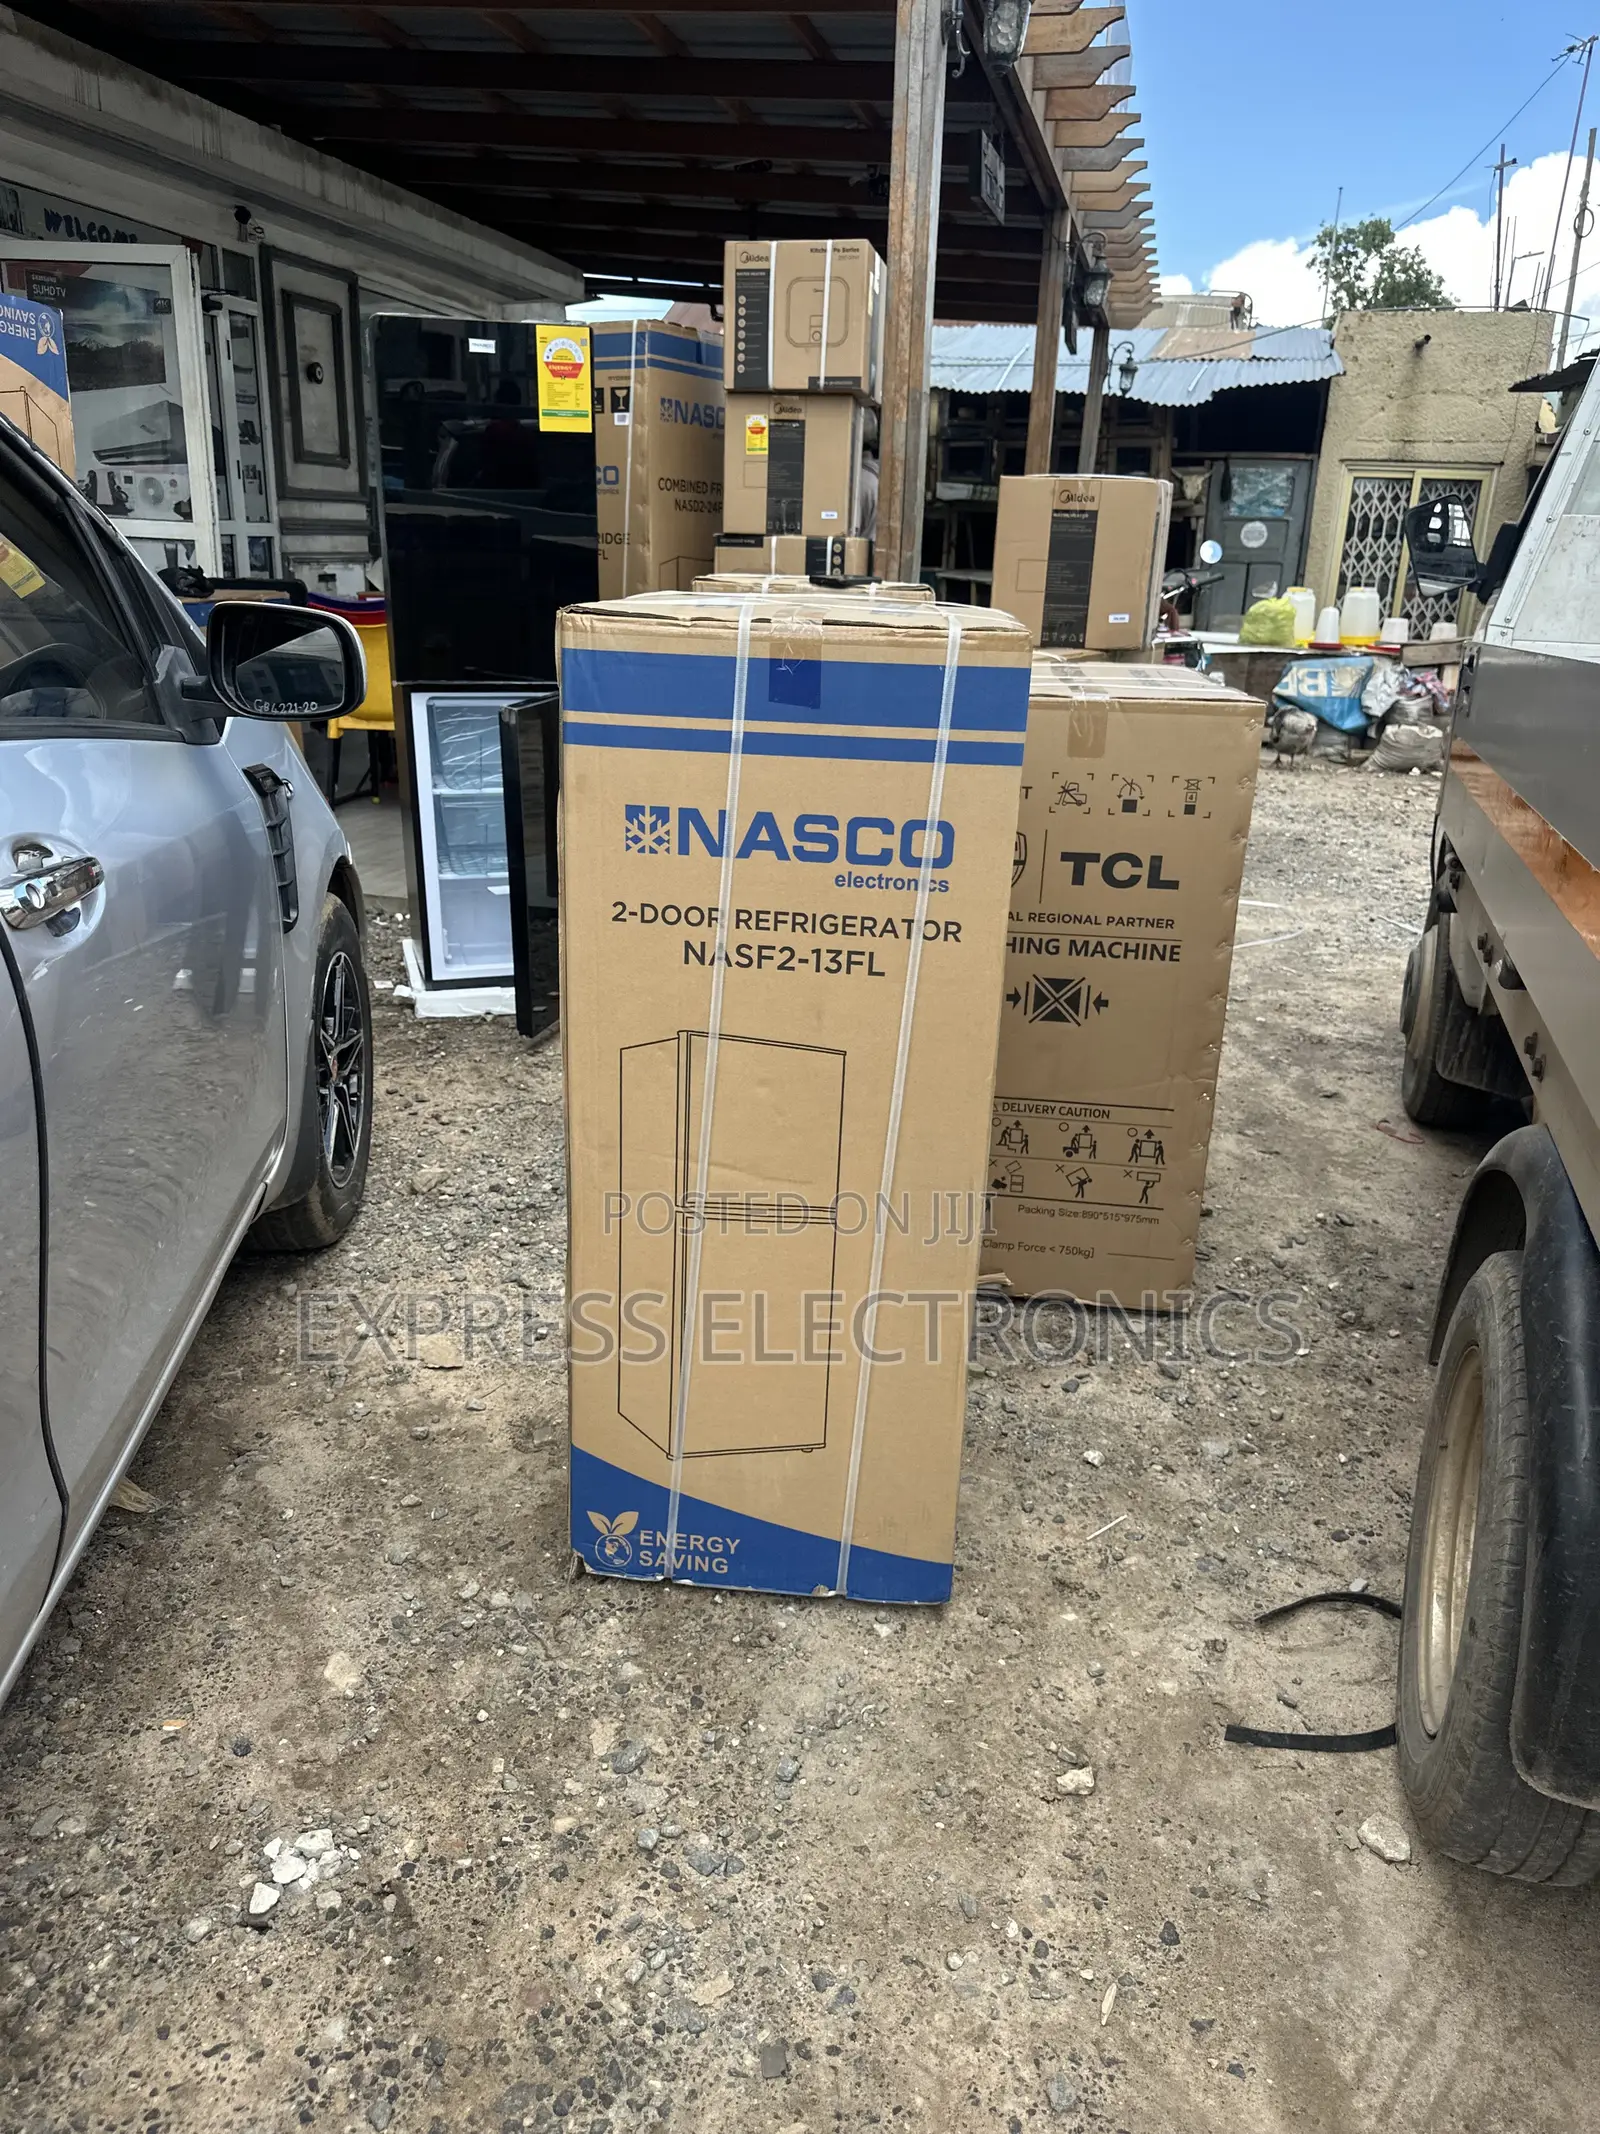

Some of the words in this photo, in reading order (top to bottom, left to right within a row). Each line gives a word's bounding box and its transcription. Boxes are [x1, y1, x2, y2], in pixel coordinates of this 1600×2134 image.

[658, 477, 709, 494] COMBINED
[1059, 489, 1096, 504] Midea
[677, 806, 956, 870] NASCO
[833, 871, 951, 894] electroncs
[1059, 851, 1180, 891] TCL
[611, 900, 727, 930] 2-DOOR
[734, 908, 963, 943] REFRIGERATOR
[1028, 912, 1103, 926] REGIONAL
[1106, 915, 1175, 930] PARTNER
[683, 939, 887, 978] NASF2-13FL
[1067, 939, 1182, 963] MACHINE
[1001, 1101, 1057, 1117] DELIVERY
[1058, 1105, 1111, 1120] CAUTION
[1017, 1204, 1056, 1218] Packing
[1017, 1241, 1047, 1254] Force
[639, 1529, 741, 1555] ENERGY
[639, 1550, 730, 1575] SAVING
